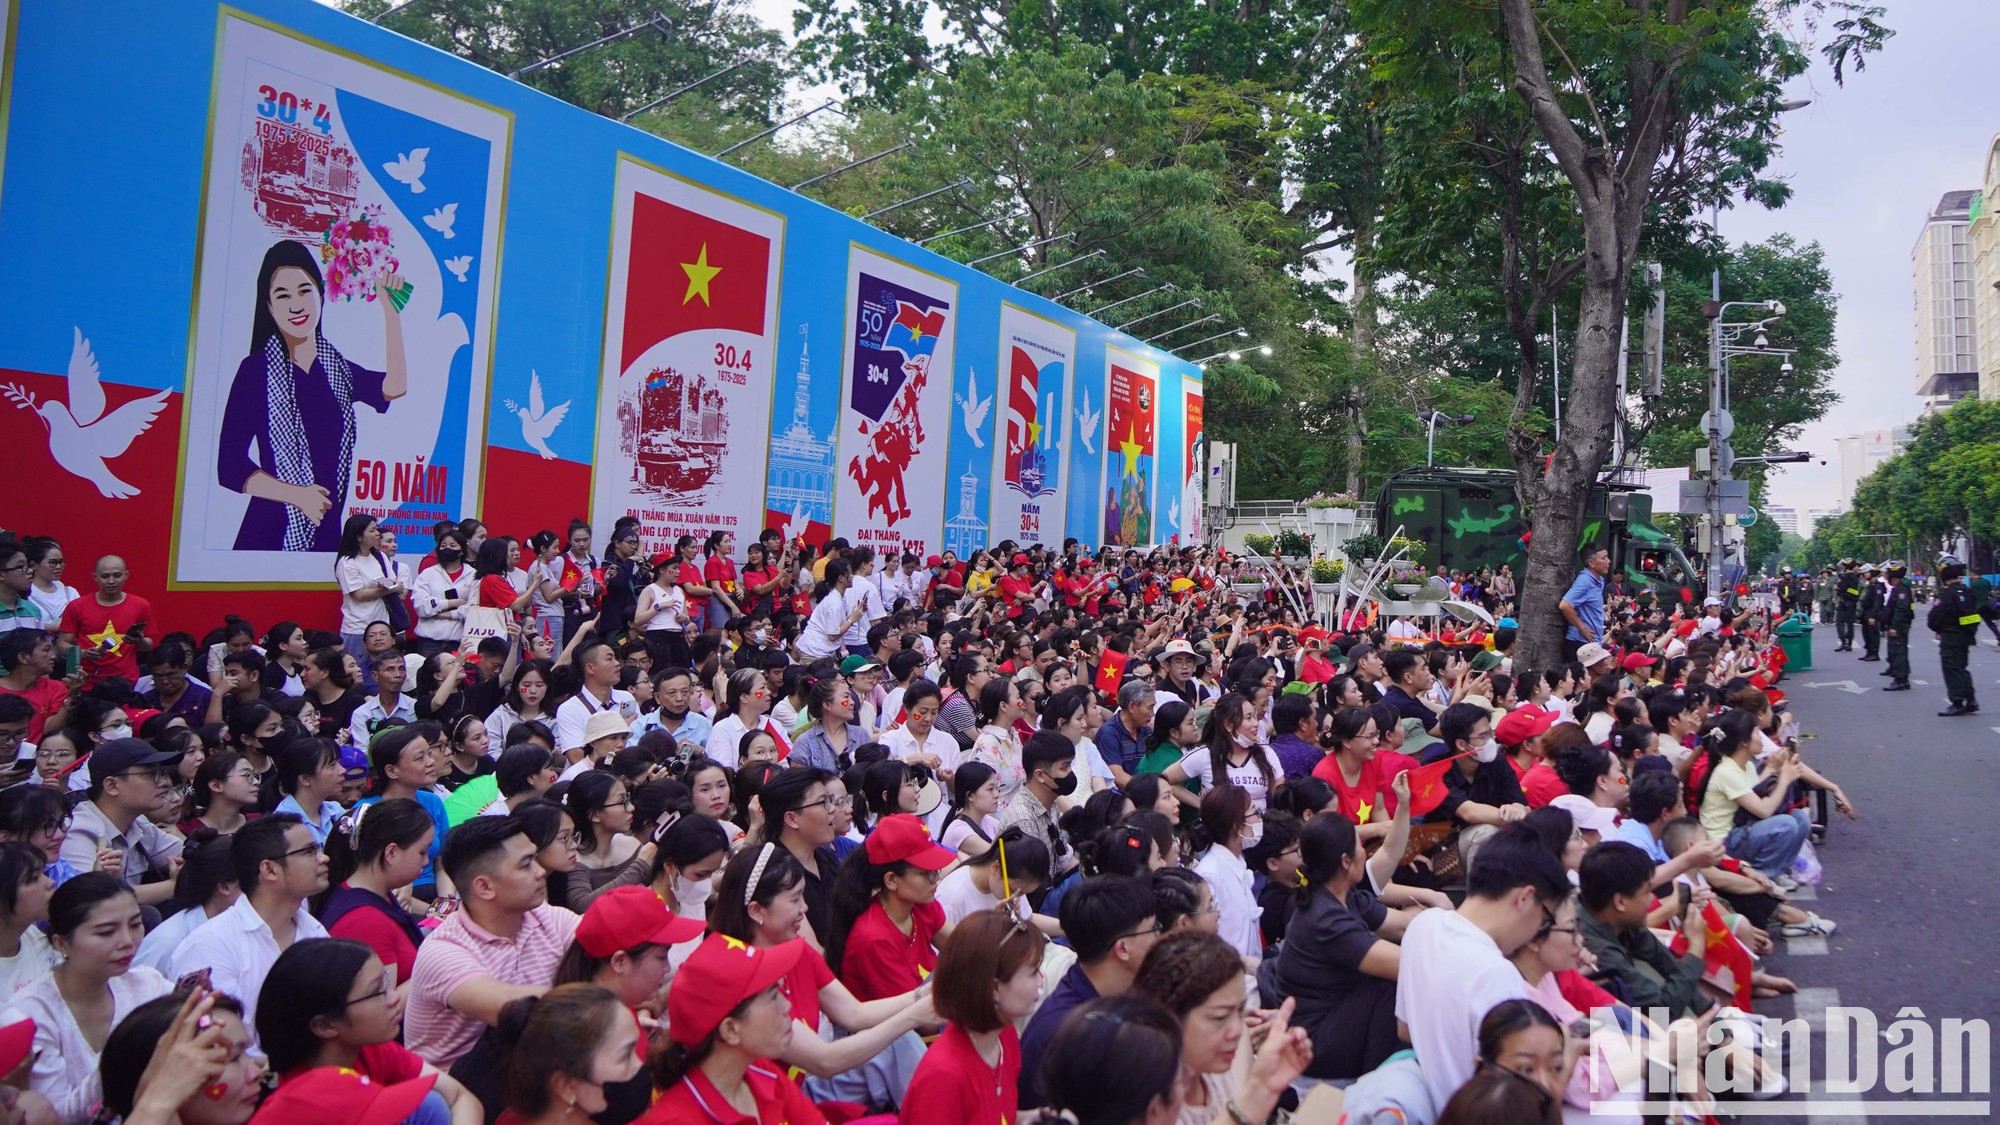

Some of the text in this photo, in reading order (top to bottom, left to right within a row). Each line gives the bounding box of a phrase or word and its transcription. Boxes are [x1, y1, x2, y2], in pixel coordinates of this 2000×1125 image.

[255, 120, 286, 144] 1975
[298, 134, 329, 156] 2025
[860, 308, 883, 338] 50
[714, 342, 752, 372] 30.4
[717, 369, 747, 386] 1975-2025
[355, 455, 448, 505] 50 NĂM
[1021, 501, 1040, 514] NĂM
[641, 508, 665, 521] THẮNG
[667, 510, 683, 523] MÙA
[685, 511, 703, 525] XUÂN
[705, 513, 720, 525] NĂM
[722, 515, 737, 526] 1975
[657, 526, 671, 539] LỢI
[693, 526, 709, 539] SỨC
[858, 528, 900, 542] ĐẠI THẮNG
[468, 627, 495, 636] JAJU
